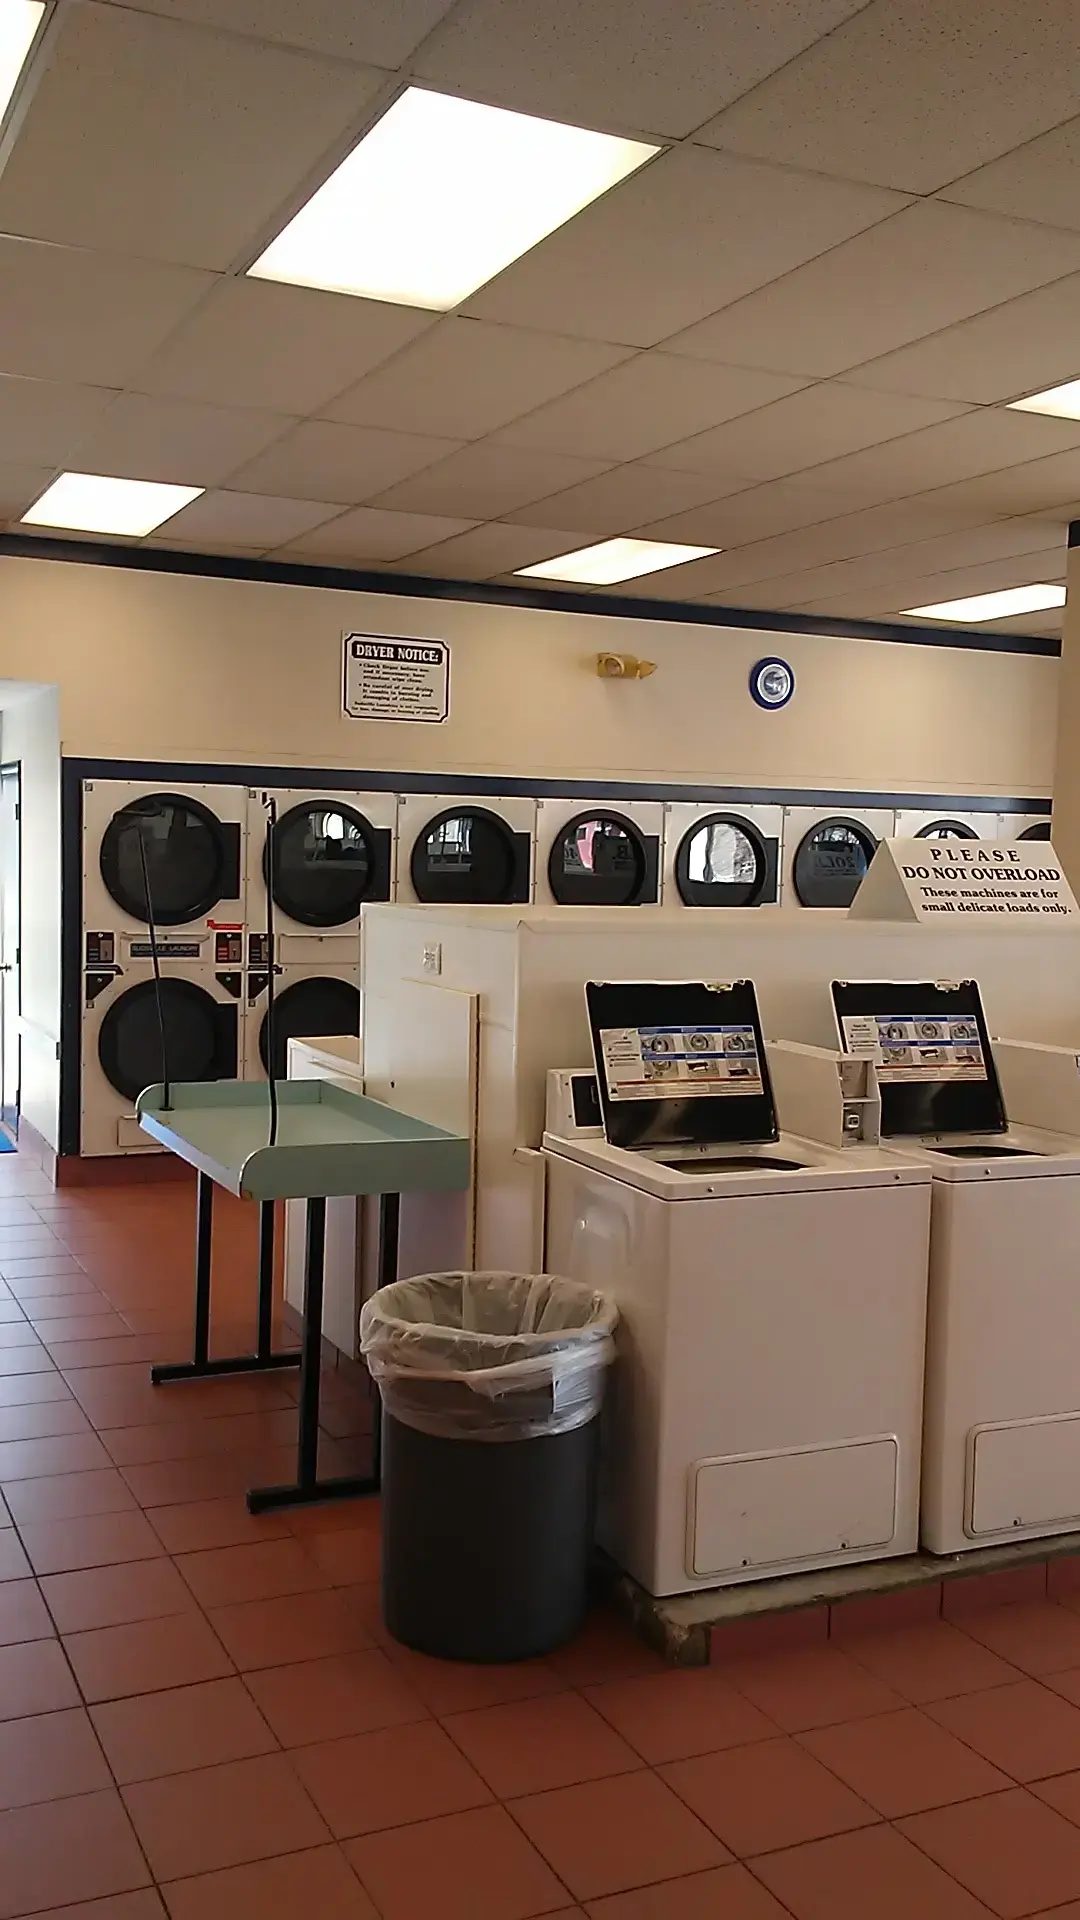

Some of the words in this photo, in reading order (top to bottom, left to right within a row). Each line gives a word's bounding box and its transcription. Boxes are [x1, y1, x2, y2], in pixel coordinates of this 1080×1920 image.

[357, 644, 394, 658] DRYER
[398, 648, 438, 662] NOTICE:
[929, 848, 1021, 862] PLEASE
[902, 866, 929, 879] DO
[932, 867, 968, 880] NOT
[971, 868, 1060, 881] OVERLOAD
[920, 887, 957, 897] These
[960, 888, 1017, 898] machines
[1042, 889, 1058, 898] for
[922, 902, 955, 912] small
[957, 903, 1005, 912] delicate
[1008, 903, 1040, 912] loads
[1042, 903, 1071, 914] only.
